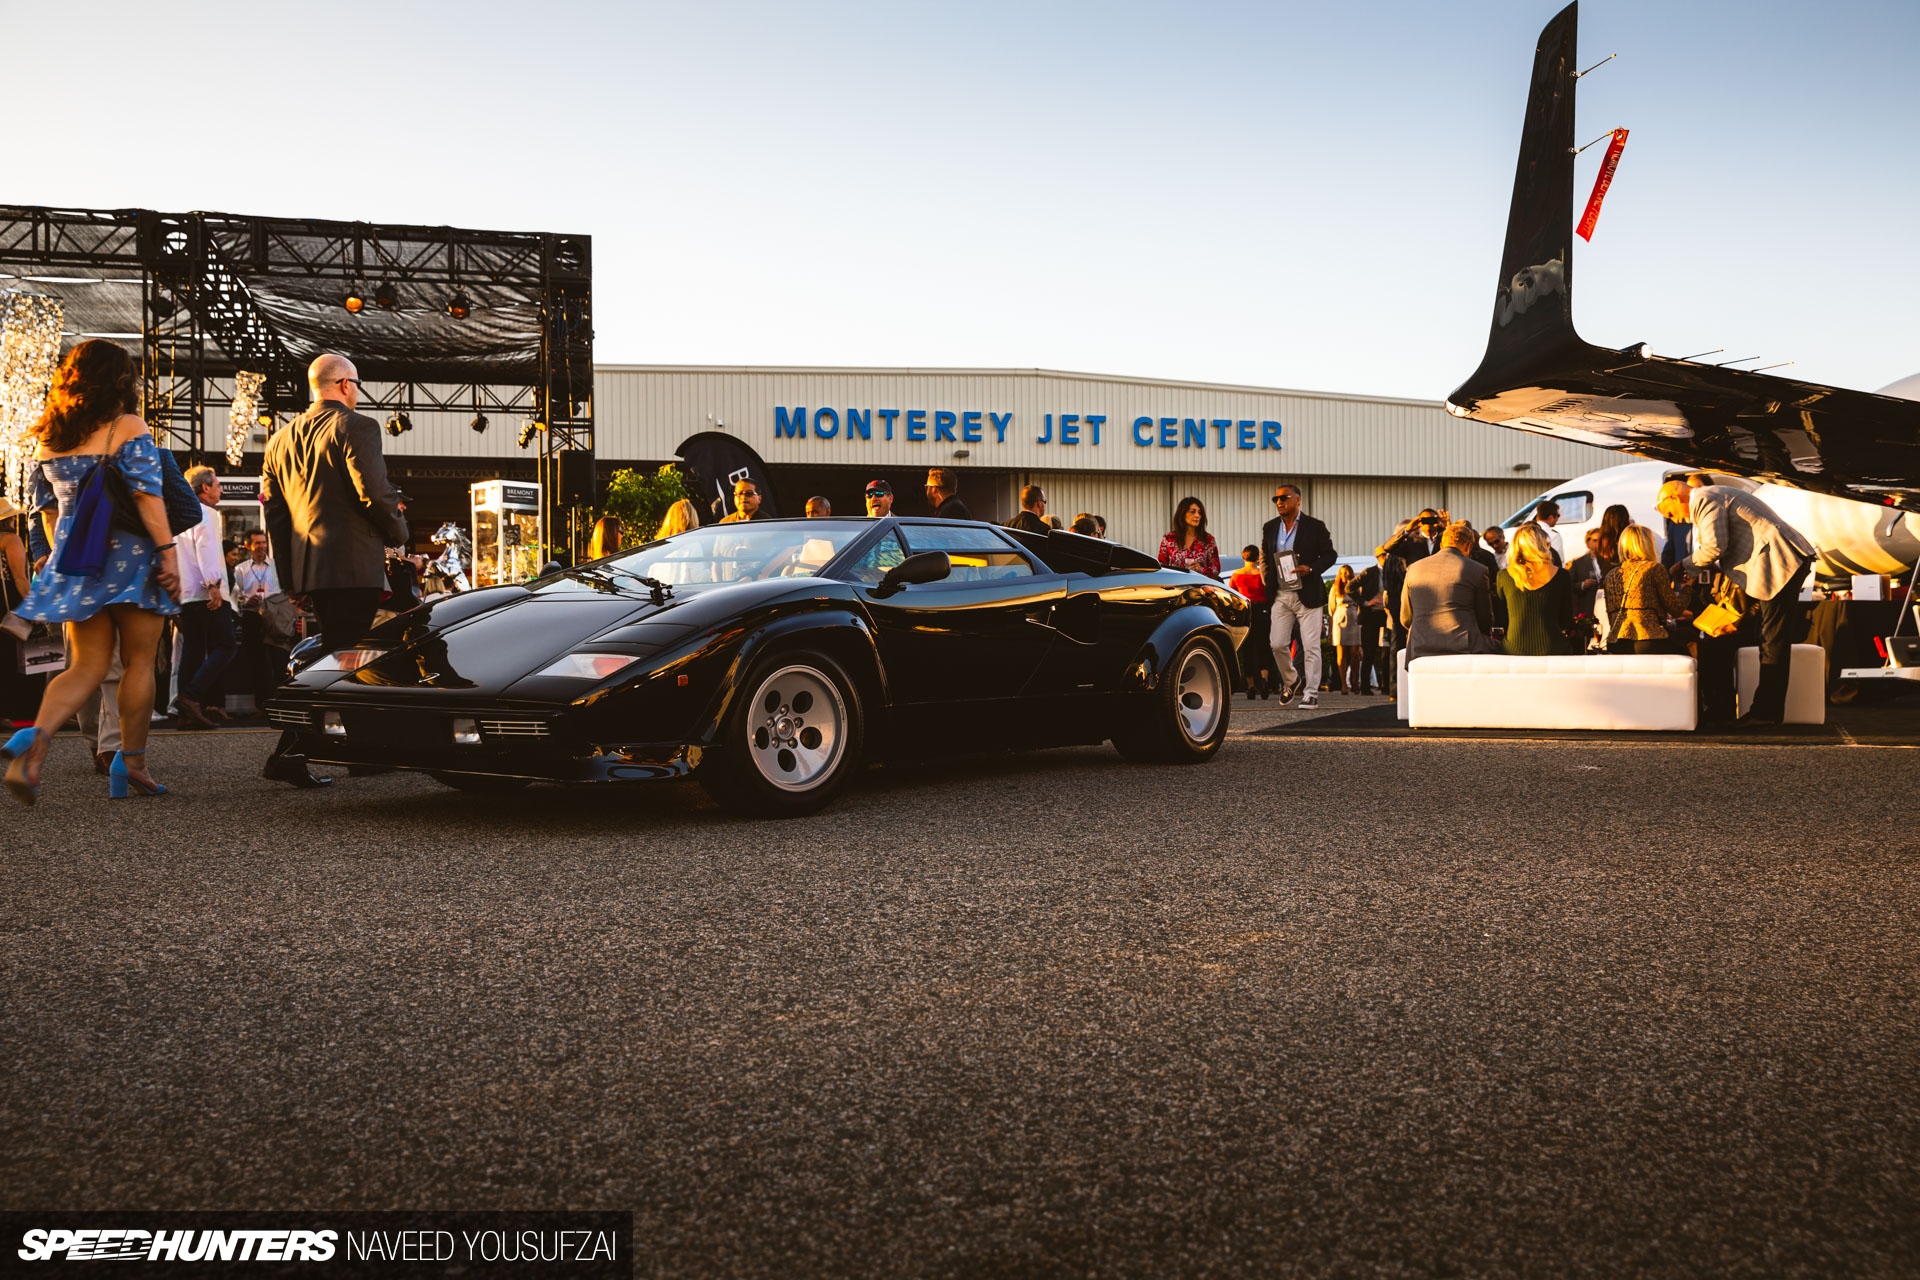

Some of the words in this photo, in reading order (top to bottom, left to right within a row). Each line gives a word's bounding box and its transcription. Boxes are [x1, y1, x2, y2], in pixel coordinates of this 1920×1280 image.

[774, 406, 1012, 442] MONTEREY
[1037, 413, 1107, 444] JET
[1132, 415, 1282, 449] CENTER
[506, 488, 534, 496] BREMONT
